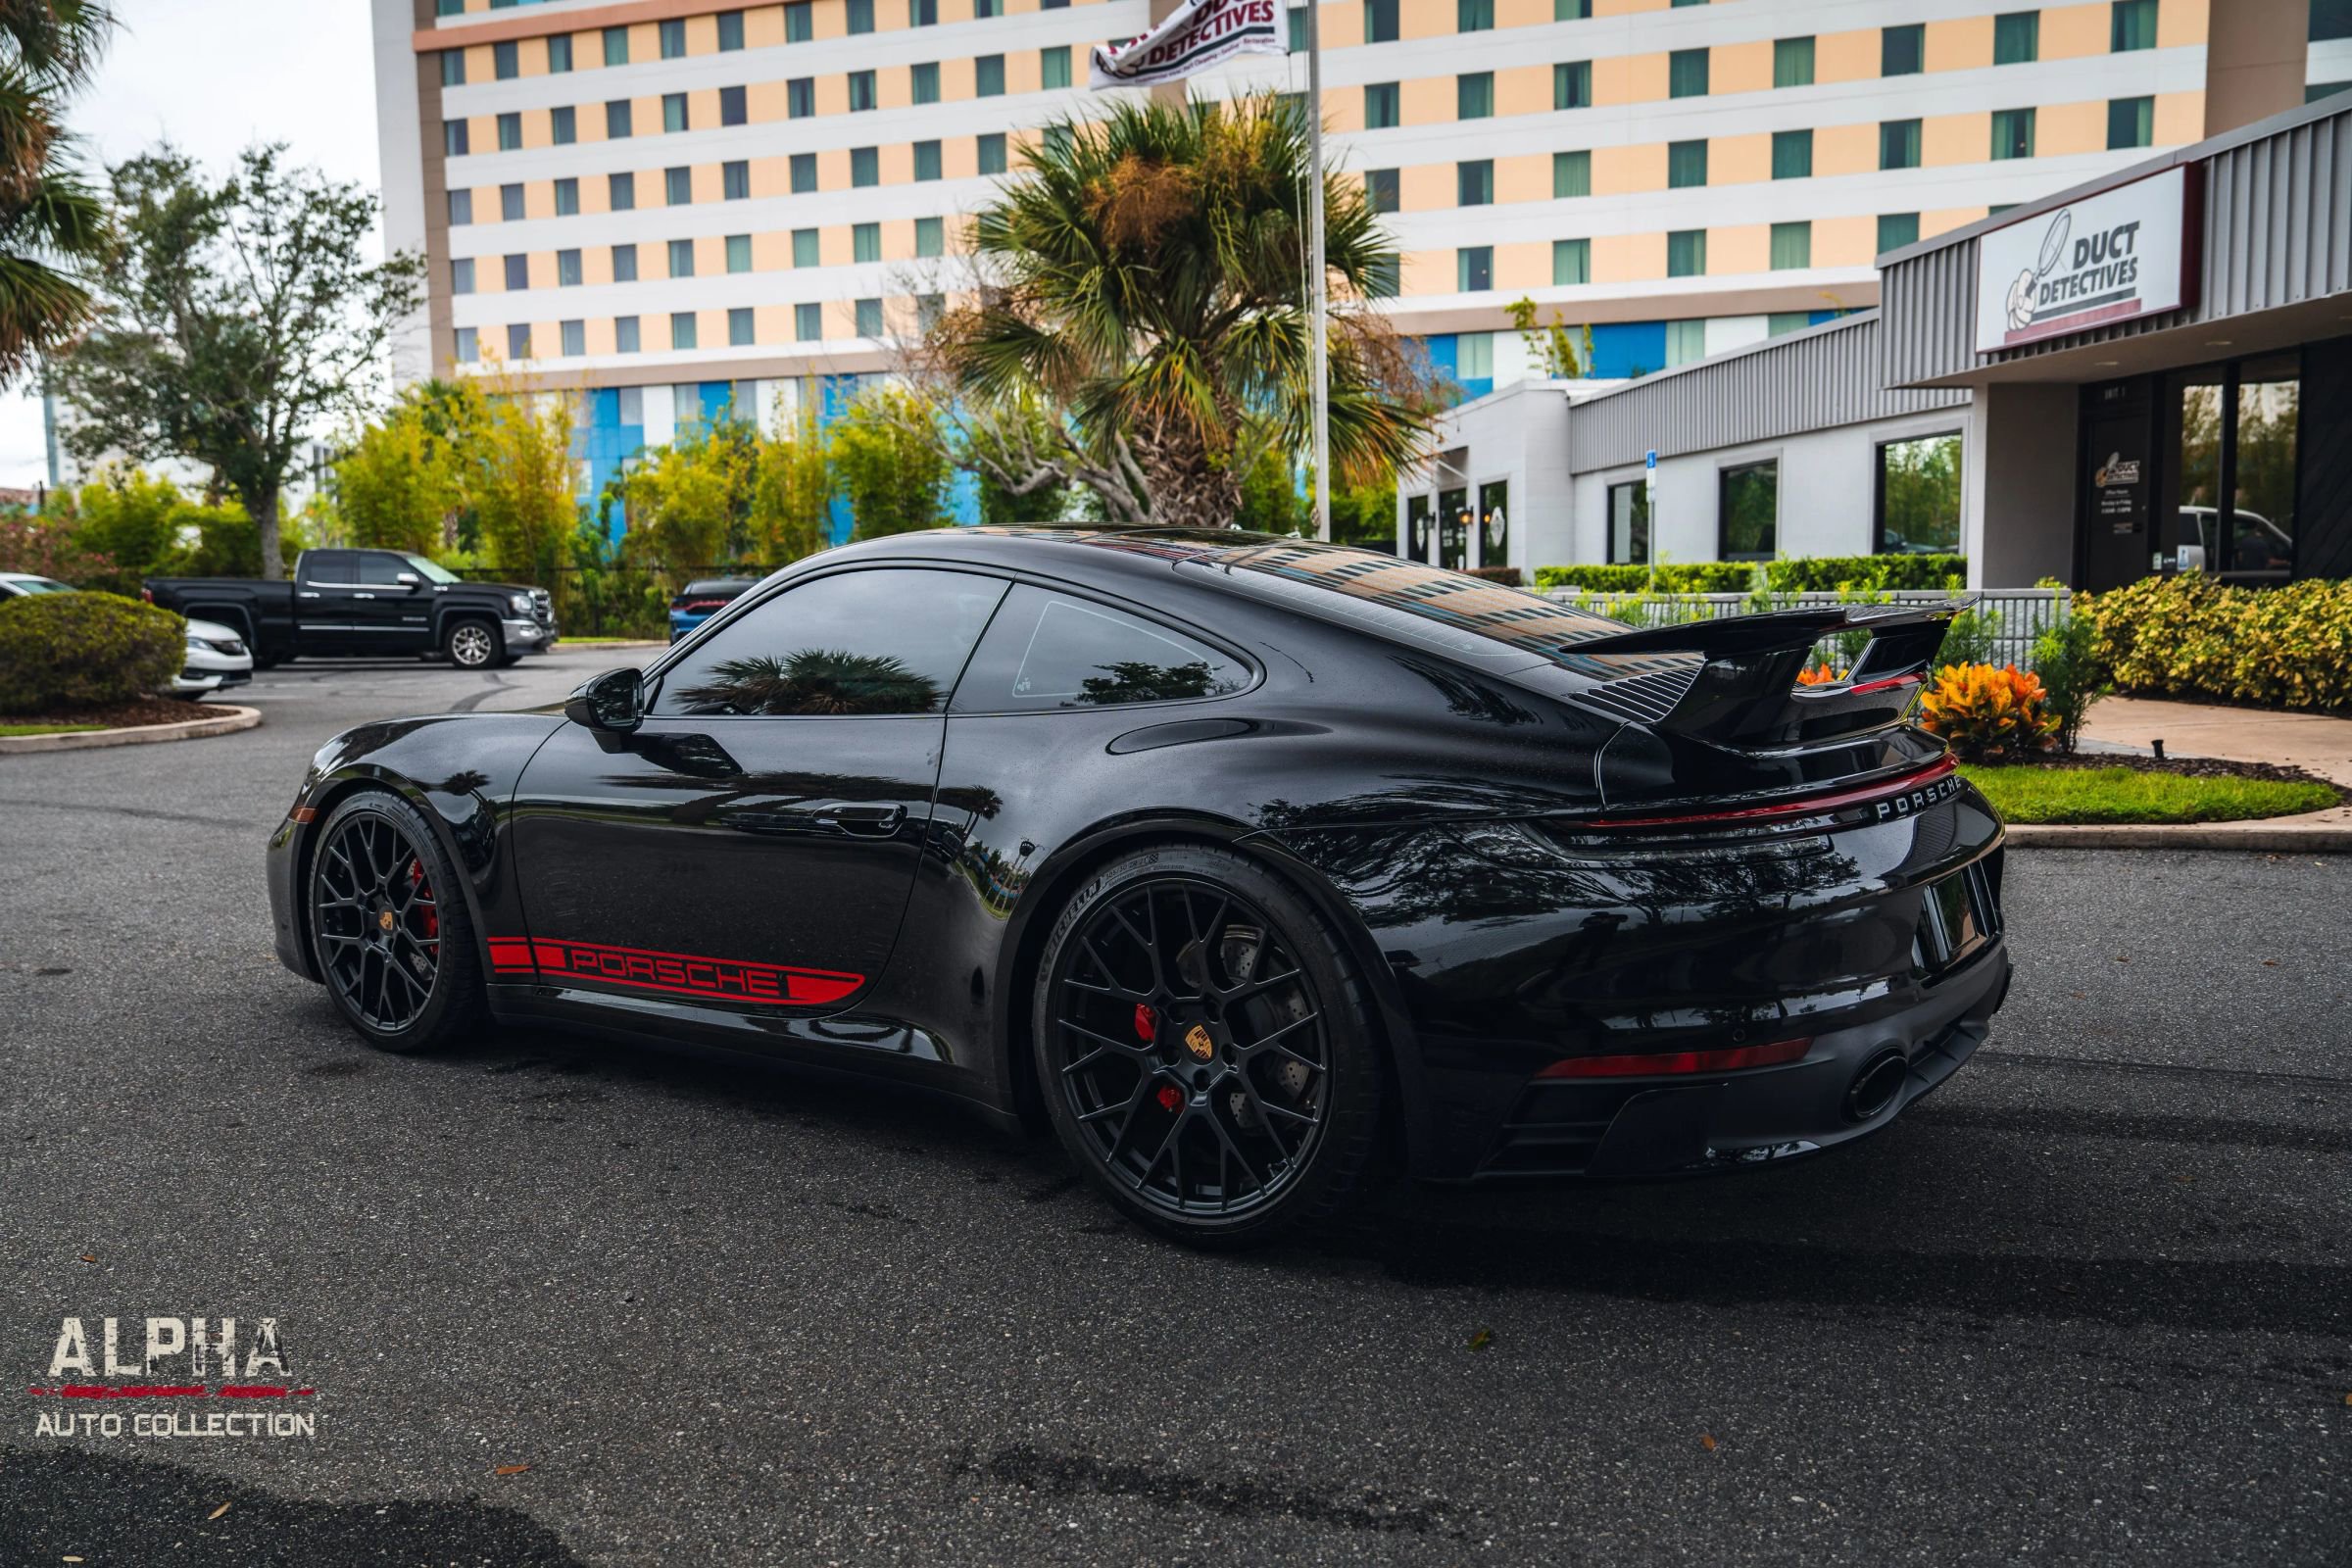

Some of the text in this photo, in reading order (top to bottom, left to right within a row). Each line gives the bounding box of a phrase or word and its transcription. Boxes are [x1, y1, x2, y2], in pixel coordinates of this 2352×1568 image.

[1149, 0, 1274, 66] DETECTIVES
[2073, 220, 2140, 270] DUCT
[2039, 257, 2138, 306] DETECTIVES
[1876, 775, 1962, 819] PORSCHE
[1049, 882, 1098, 958] MICHELIN
[571, 949, 781, 996] PORSCHE
